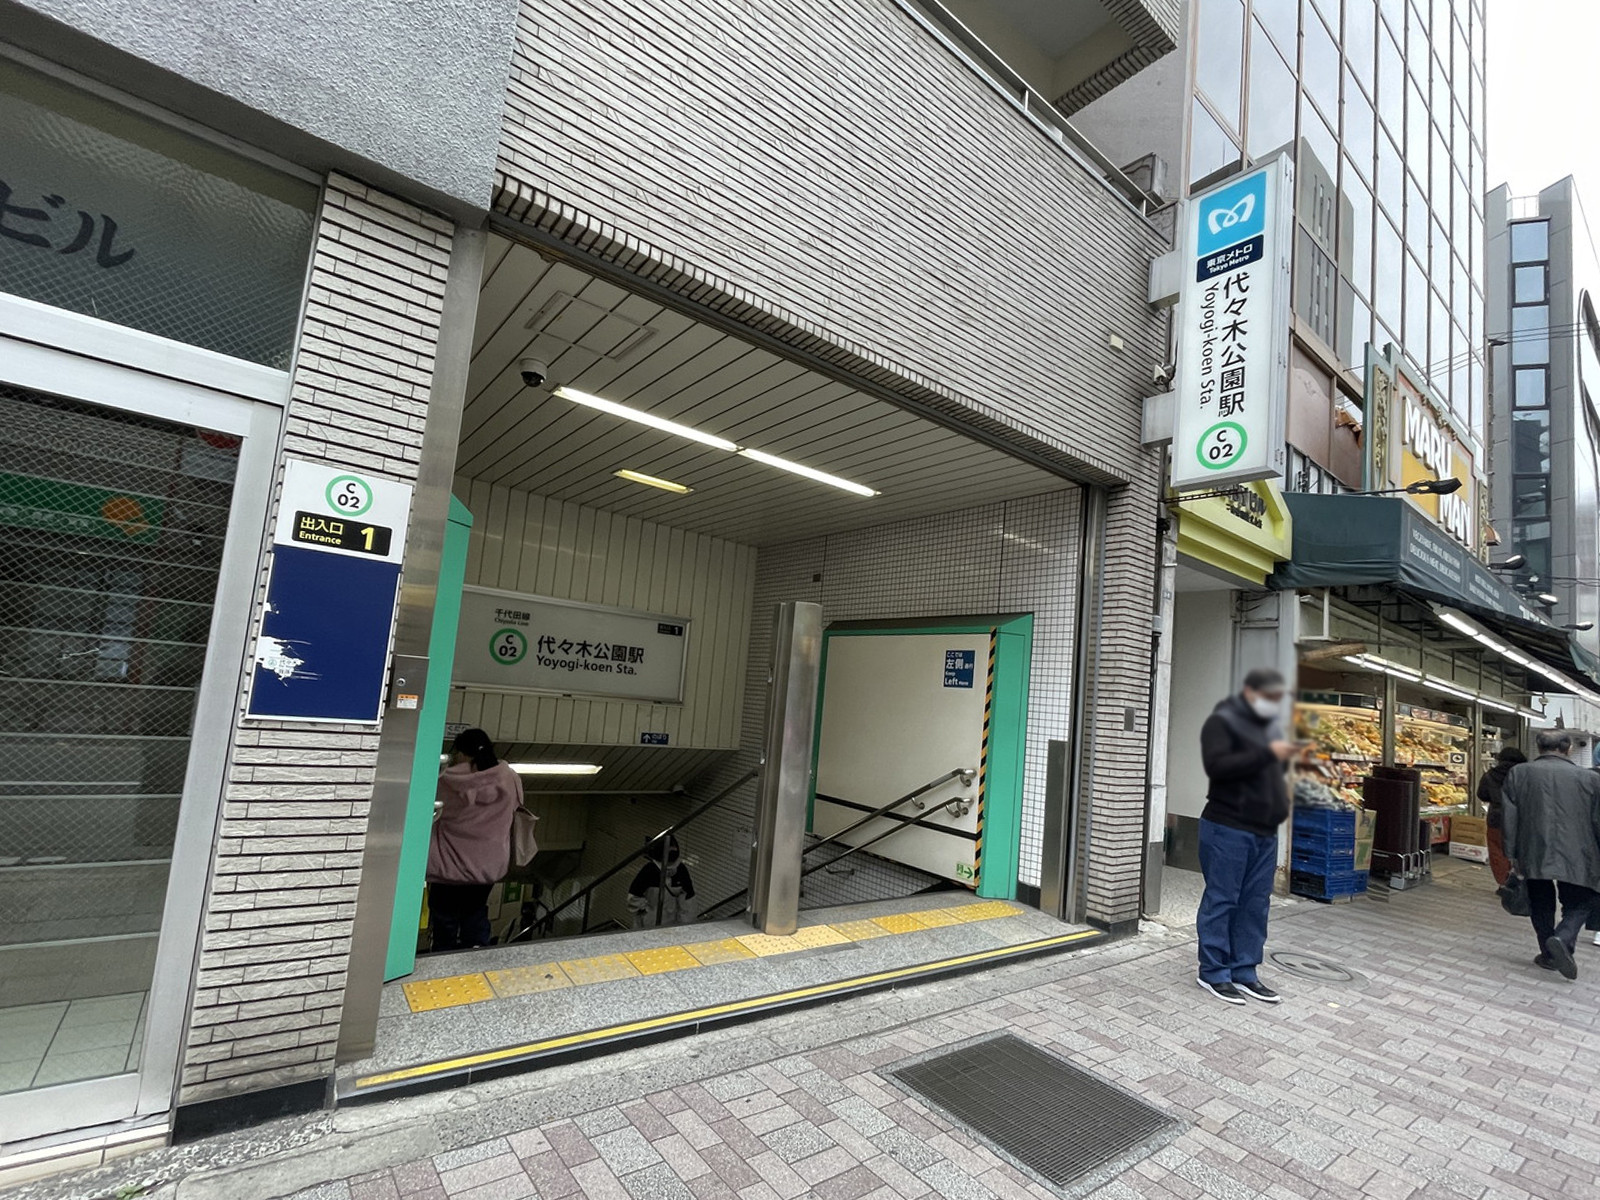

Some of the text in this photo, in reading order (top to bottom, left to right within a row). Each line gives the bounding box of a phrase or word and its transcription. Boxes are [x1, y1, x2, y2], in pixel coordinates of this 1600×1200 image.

[1206, 244, 1253, 269] 東京メトロ
[1209, 255, 1250, 273] Tokyo Metro
[1199, 282, 1219, 410] Yoyogi-koen Sta.
[1218, 271, 1250, 418] 代々木公園駅
[1216, 429, 1227, 443] C
[1403, 396, 1452, 480] MARU
[1209, 443, 1233, 460] 02
[346, 483, 356, 494] C
[337, 494, 360, 509] 02
[300, 516, 344, 535] 出入口
[1439, 493, 1471, 546] MAN
[299, 531, 342, 545] Entrance
[360, 527, 375, 551] 1
[495, 608, 531, 621] 千代田線
[505, 634, 514, 645] C
[499, 645, 517, 657] 02
[537, 635, 645, 664] 代々木公園駅
[536, 654, 637, 676] Yoyogi-koen Sta.
[944, 677, 958, 685] Left
